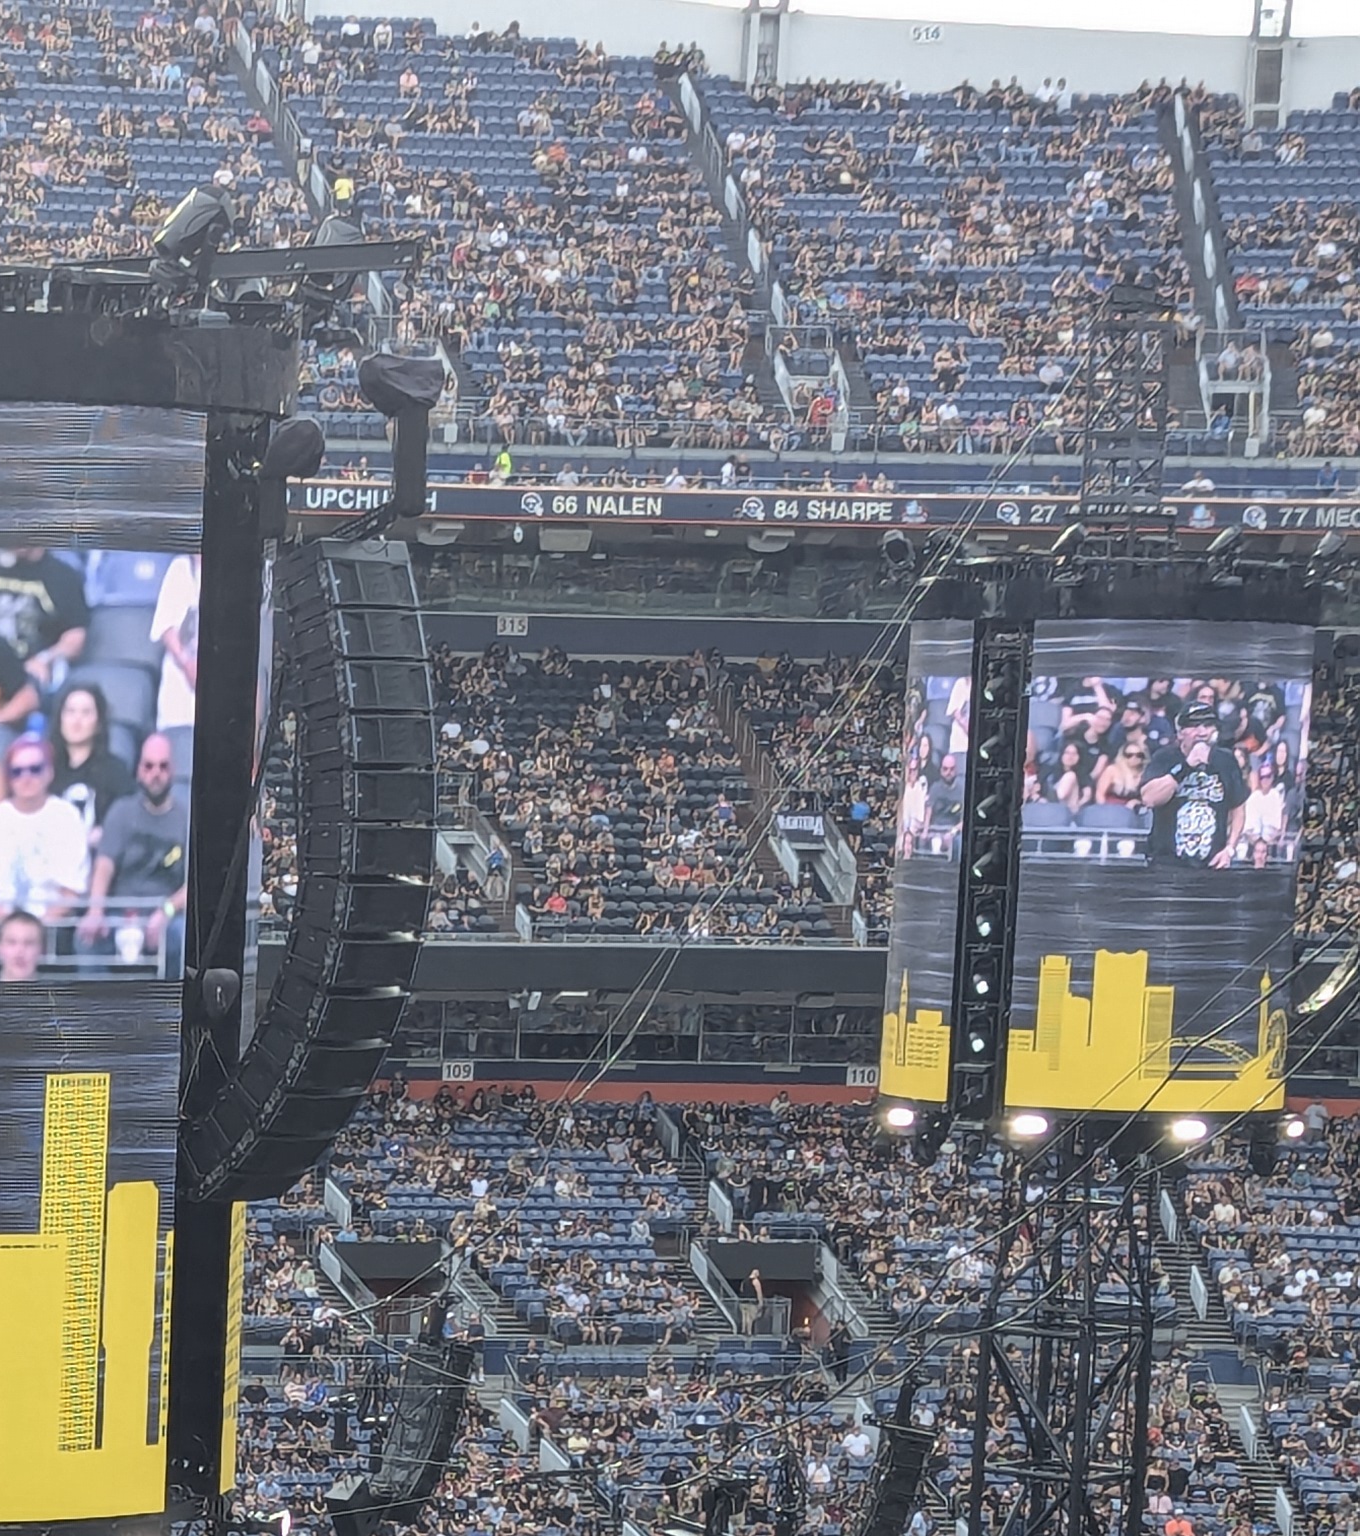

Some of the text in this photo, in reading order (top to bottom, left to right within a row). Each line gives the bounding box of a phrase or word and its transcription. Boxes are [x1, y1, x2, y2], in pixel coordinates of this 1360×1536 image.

[306, 487, 438, 512] UPCHUH
[552, 496, 662, 516] 66 NALEN
[773, 501, 892, 521] 84 SHARPE
[1030, 504, 1057, 524] 27
[1278, 507, 1310, 527] 77
[445, 1064, 472, 1079] 109
[851, 1068, 876, 1084] 110
